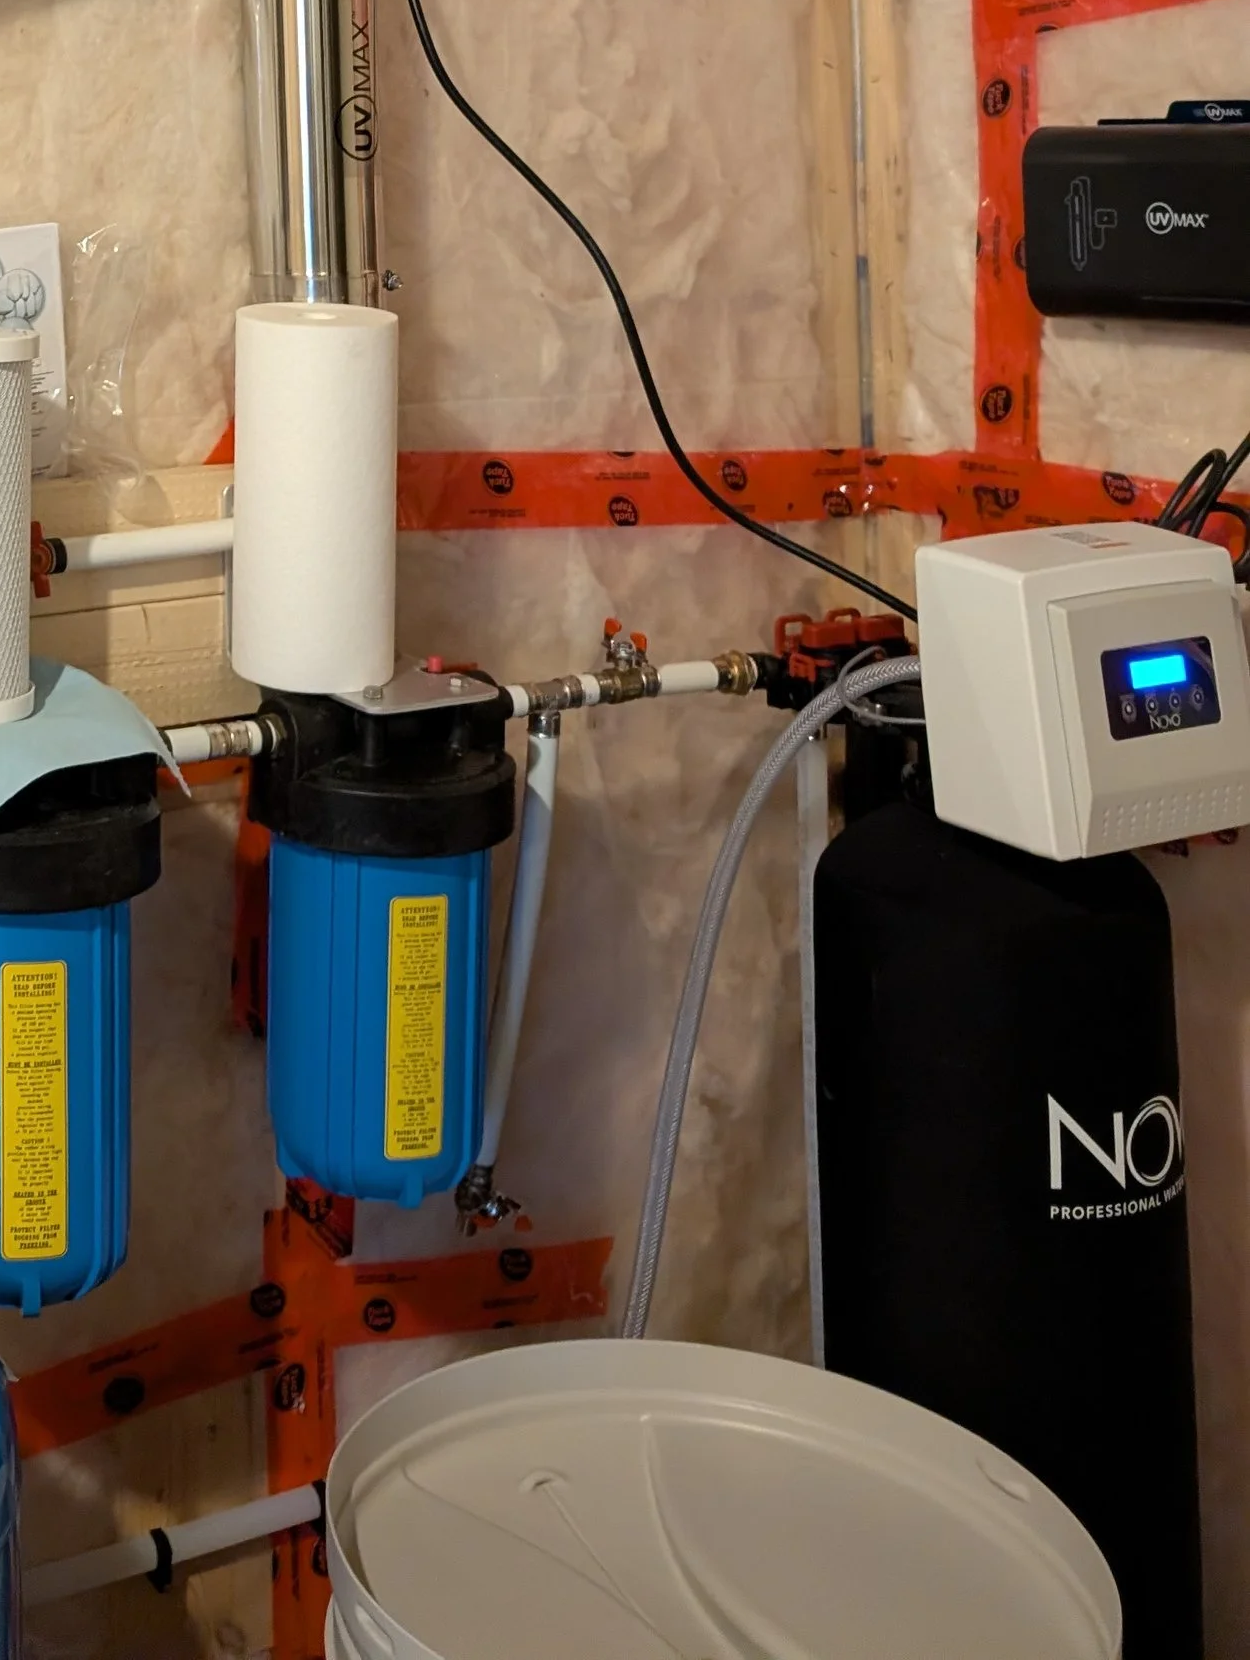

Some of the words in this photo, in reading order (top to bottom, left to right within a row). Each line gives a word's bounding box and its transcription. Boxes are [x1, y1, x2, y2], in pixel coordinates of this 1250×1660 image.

[12, 972, 58, 982] ATTENTION!
[1047, 1093, 1186, 1191] NO
[1050, 1192, 1162, 1221] PROFESSIONAL
